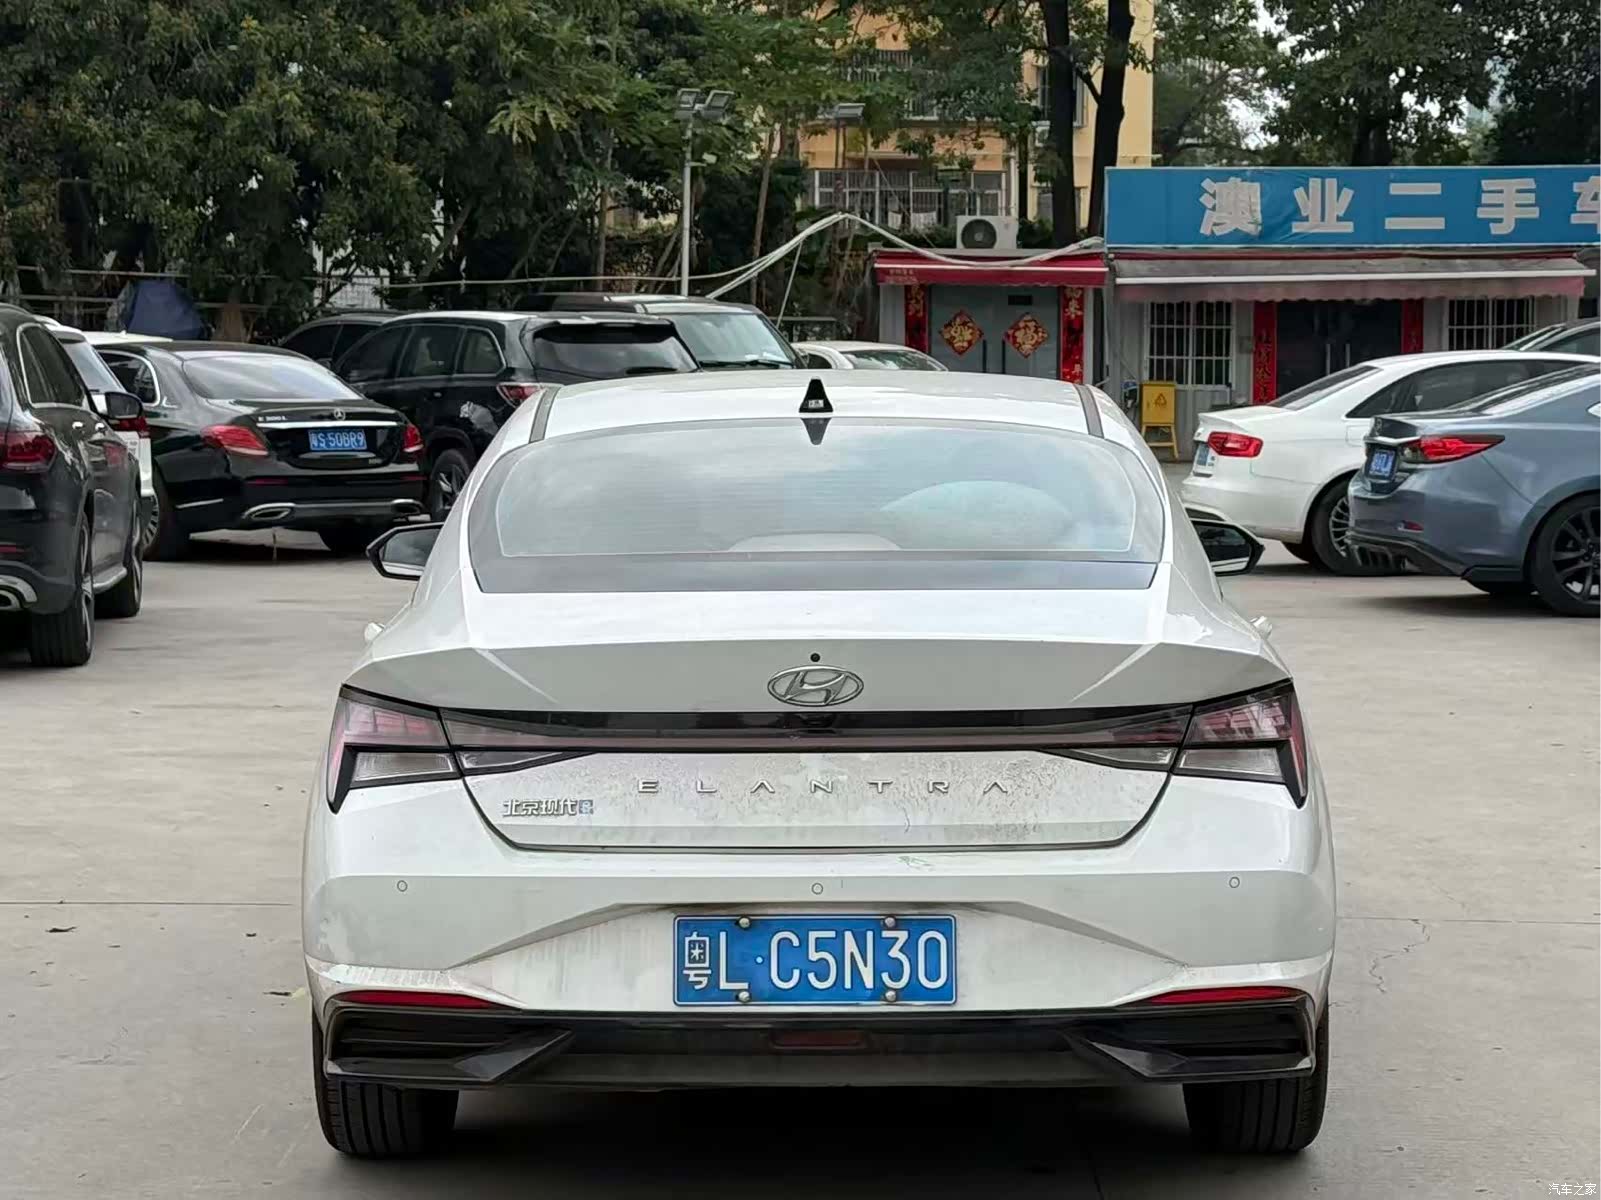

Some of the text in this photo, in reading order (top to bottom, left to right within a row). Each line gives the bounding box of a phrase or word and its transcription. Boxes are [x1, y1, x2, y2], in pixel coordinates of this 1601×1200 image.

[637, 779, 1008, 795] ELANTRA
[503, 799, 577, 816] 北京现代
[682, 930, 949, 990] 粤L·C5N30
